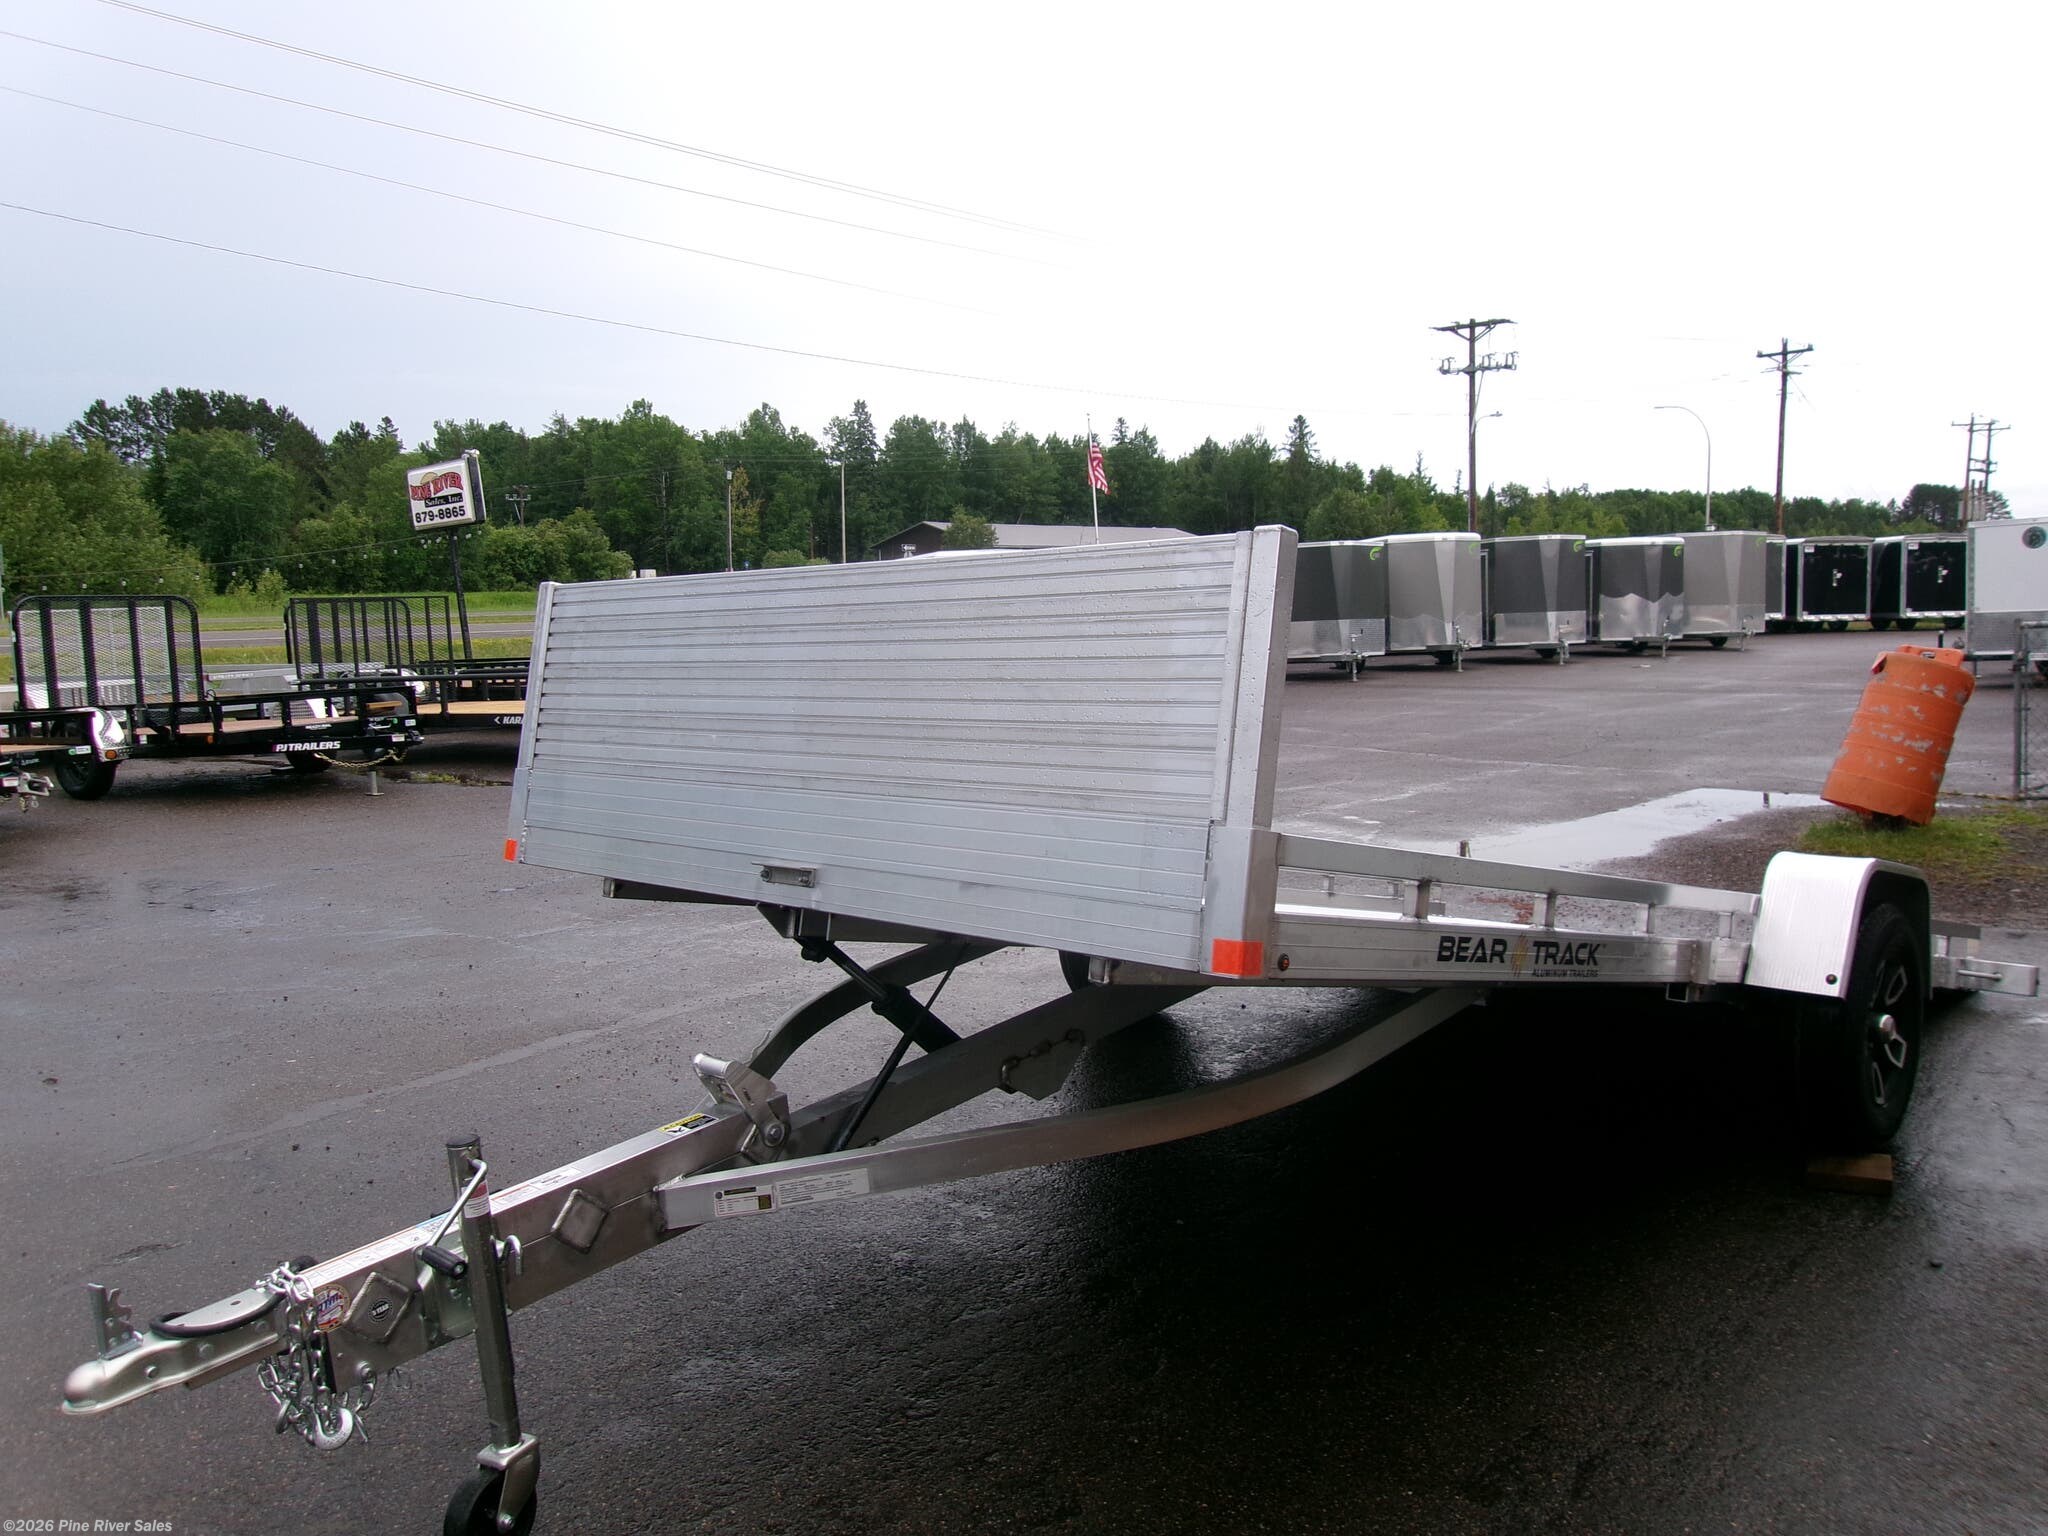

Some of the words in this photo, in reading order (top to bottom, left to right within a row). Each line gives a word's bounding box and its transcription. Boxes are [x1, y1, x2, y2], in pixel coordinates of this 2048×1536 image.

[432, 472, 463, 495] RIVER
[415, 505, 466, 523] 879-8865
[503, 716, 523, 724] KAR
[1437, 936, 1507, 963] BEAR
[1533, 941, 1601, 966] TRACK
